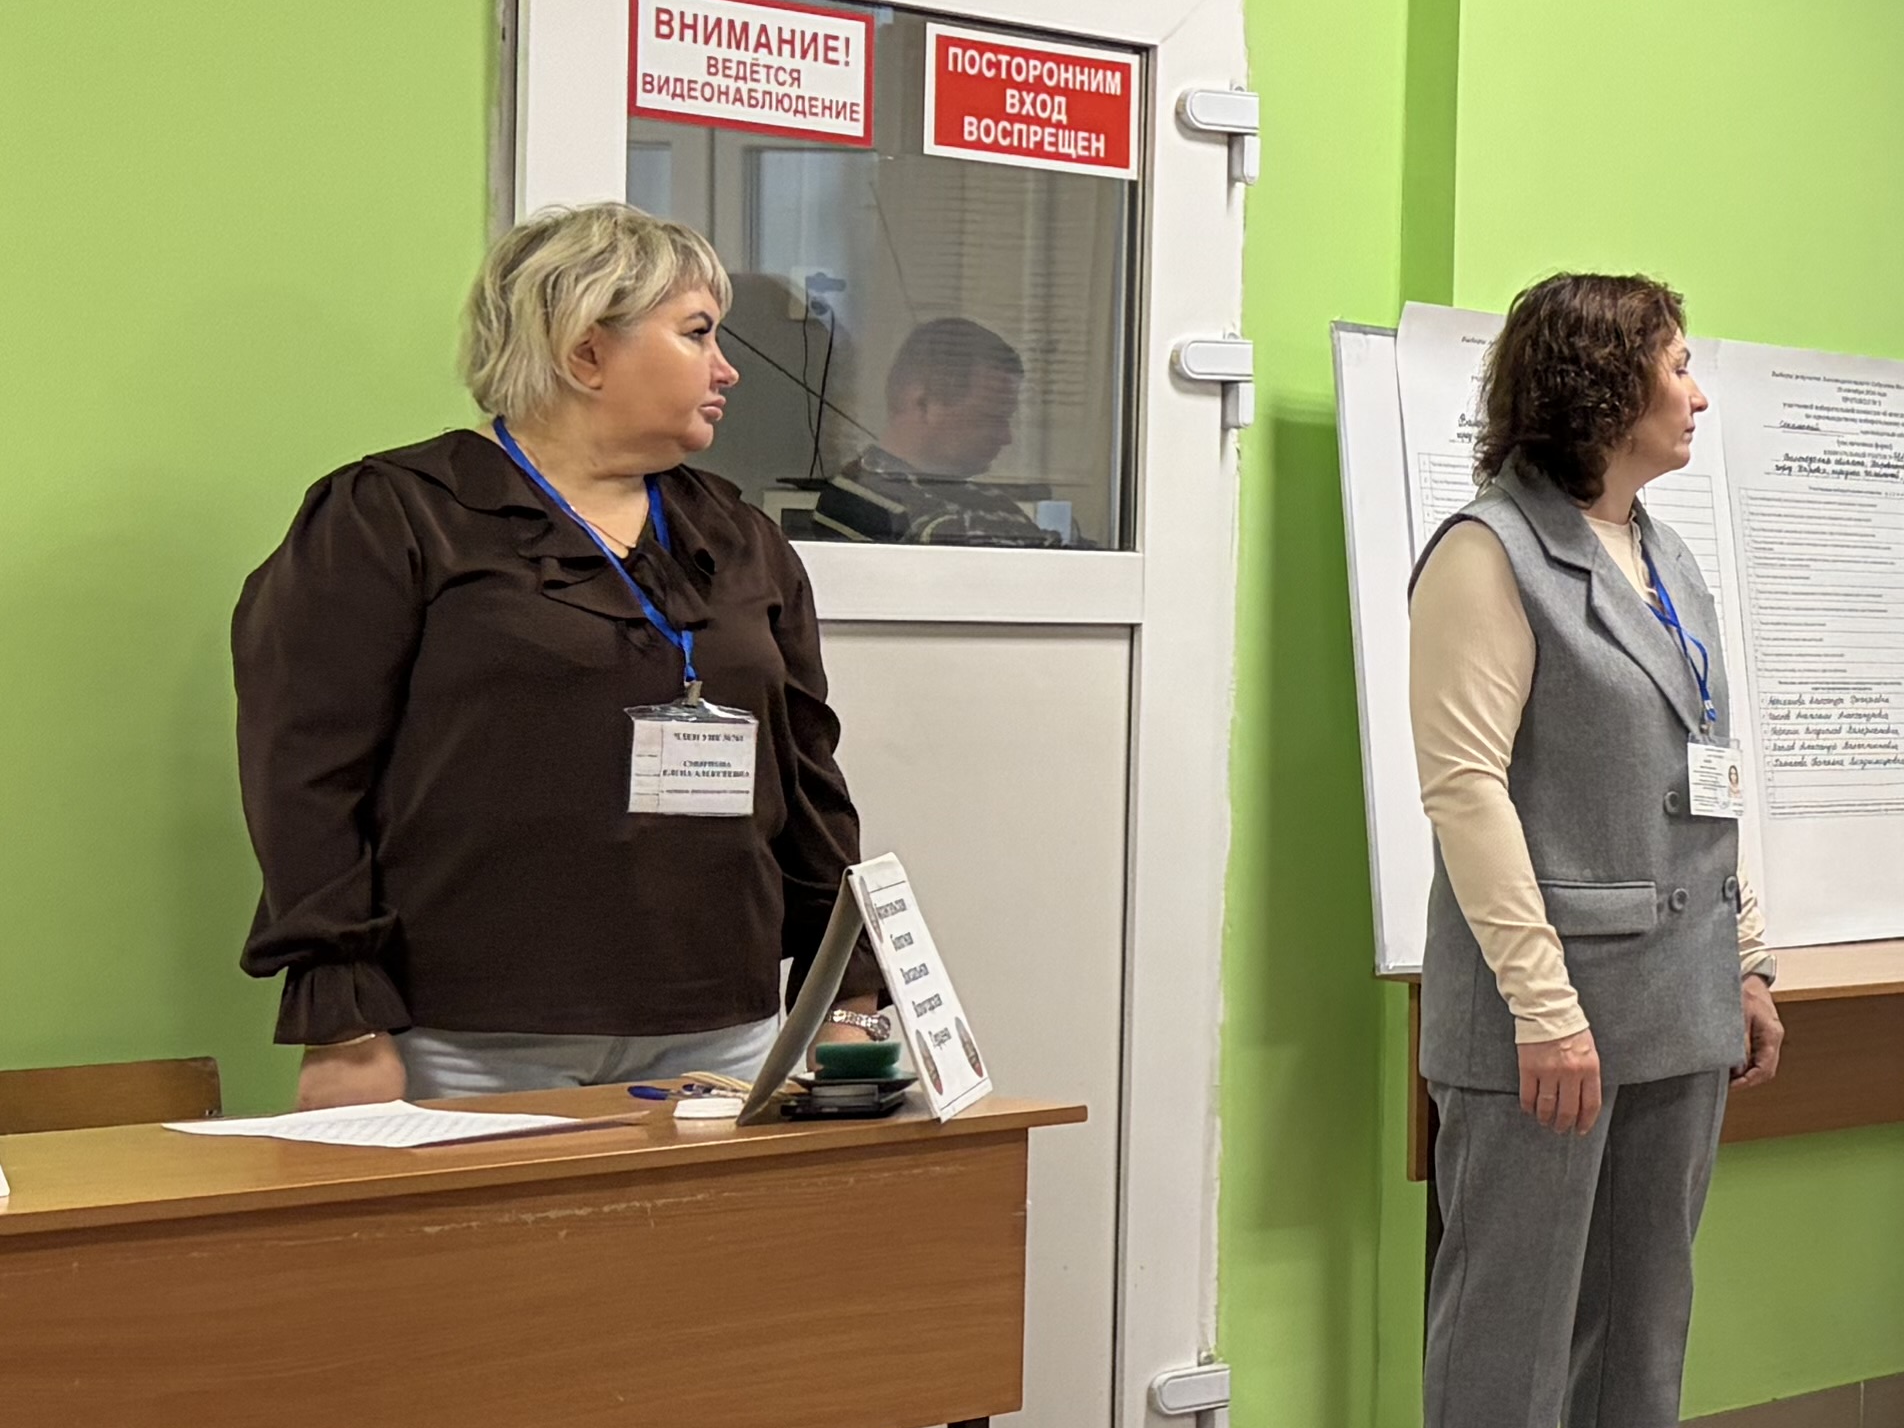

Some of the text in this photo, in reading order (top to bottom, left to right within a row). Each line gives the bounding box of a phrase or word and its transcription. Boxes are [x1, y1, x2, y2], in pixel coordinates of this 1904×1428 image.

[654, 6, 852, 67] ВНИМАНИЕ!
[706, 55, 802, 90] ВЕДЁТСЯ
[947, 46, 1122, 96] ПОСТОРОННИМ
[641, 72, 861, 123] ВИДЕОНАБЛЮДЕНИЕ
[1005, 90, 1068, 125] ВХОД
[963, 115, 1106, 160] ВОСПРЕЩЕН
